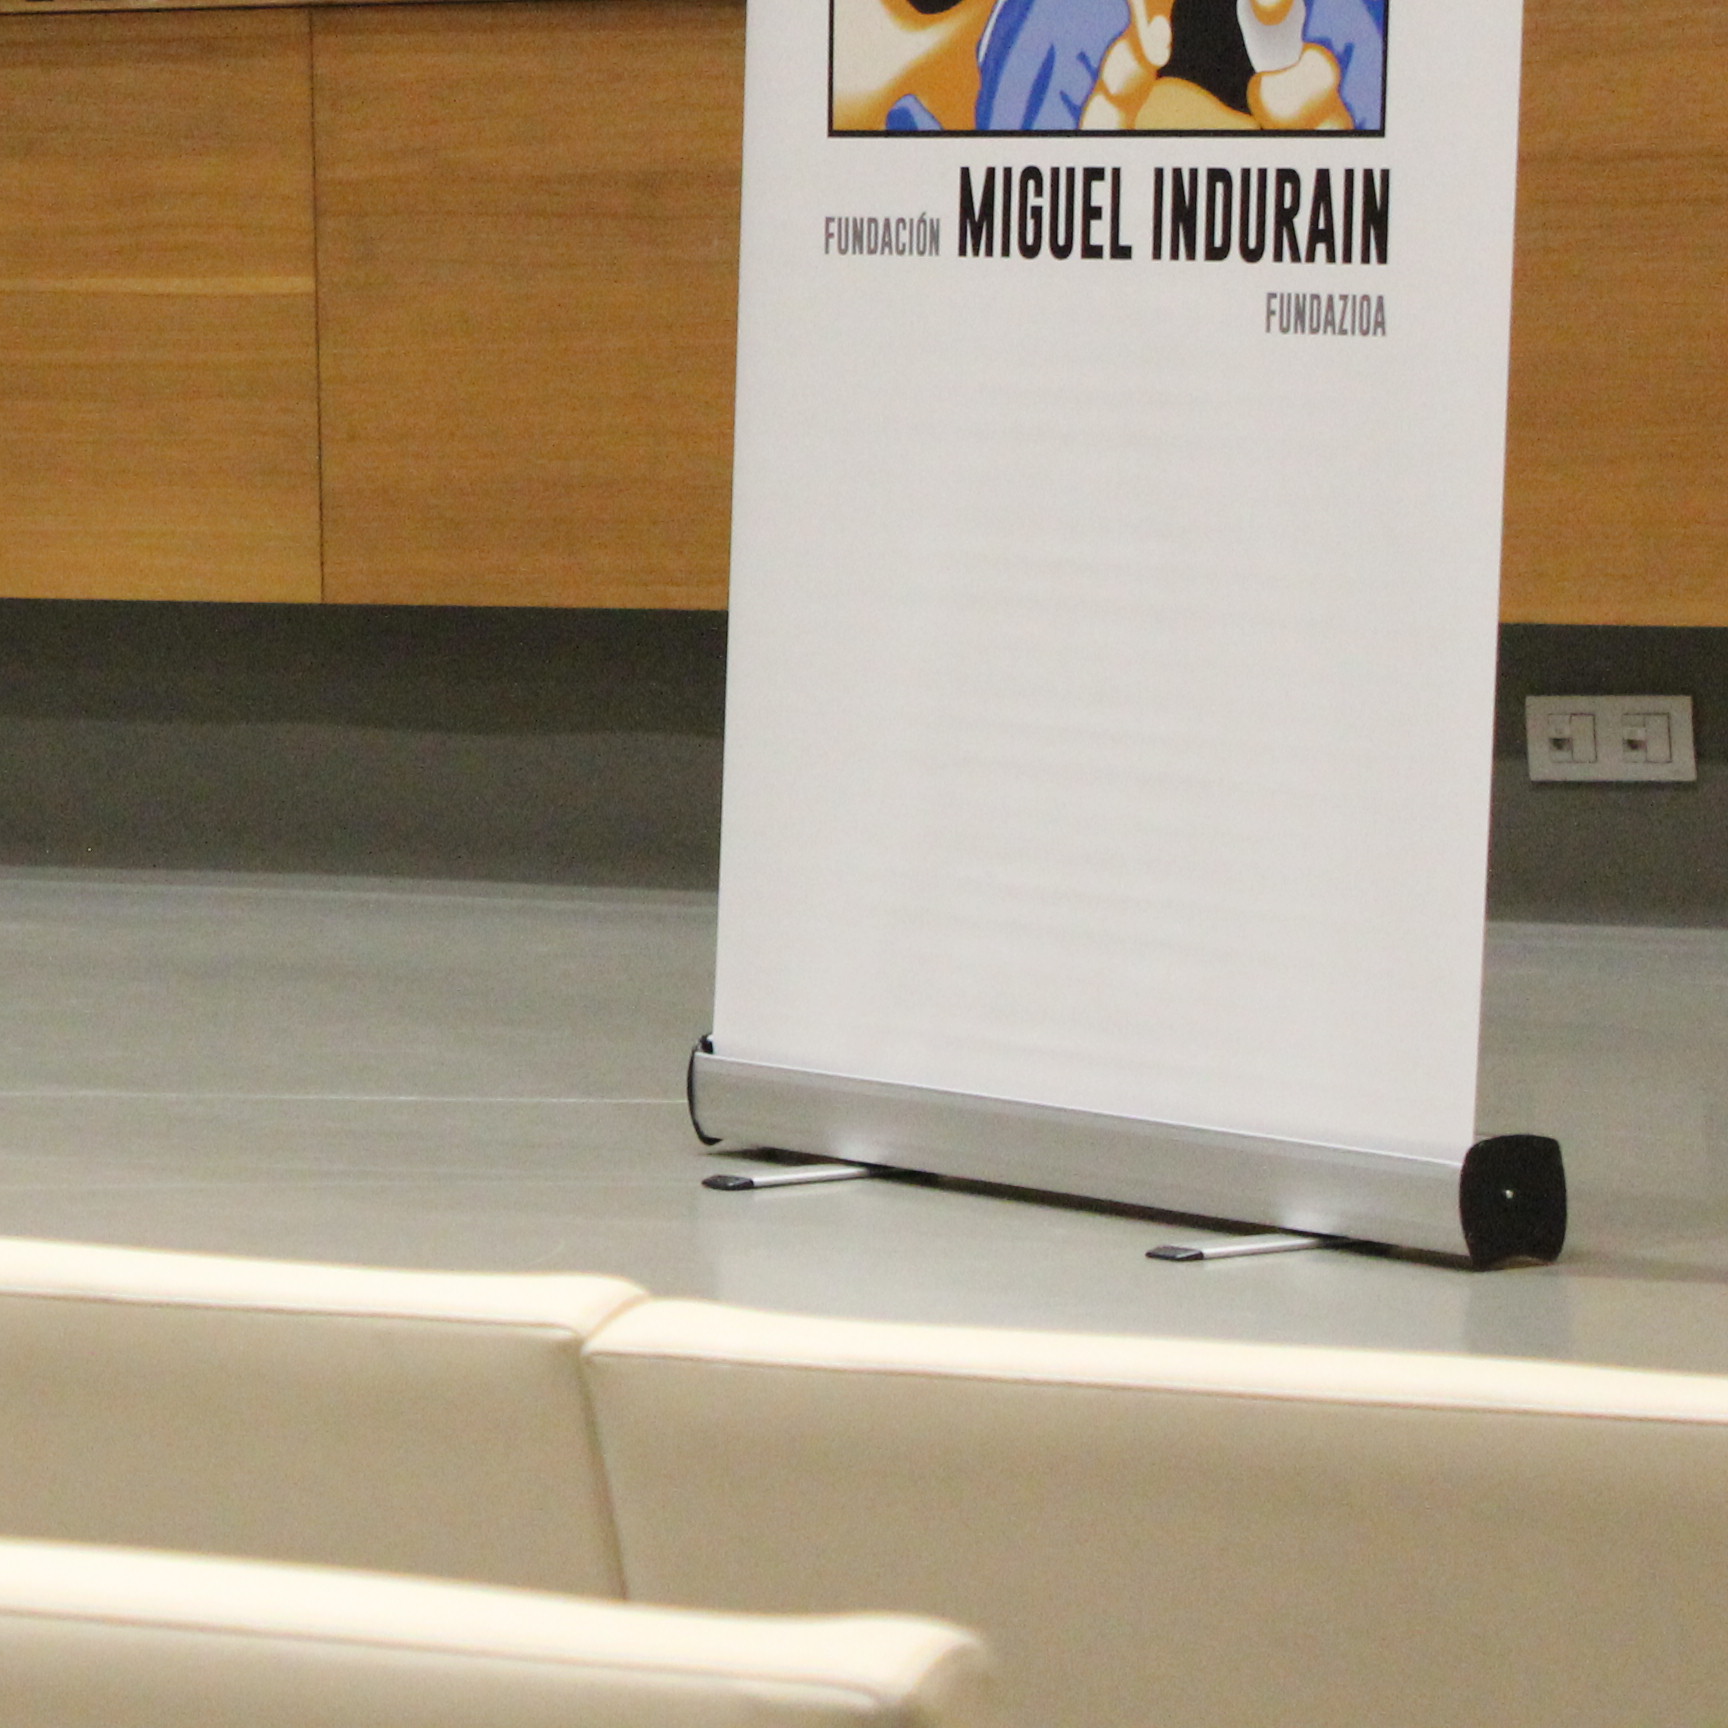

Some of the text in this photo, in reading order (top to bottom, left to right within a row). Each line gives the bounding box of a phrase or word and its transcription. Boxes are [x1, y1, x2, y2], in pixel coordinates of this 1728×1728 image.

[824, 165, 1391, 265] FUNDACIÓN MIGUEL INDURAIN
[1265, 292, 1387, 337] FUNDAZIOA
